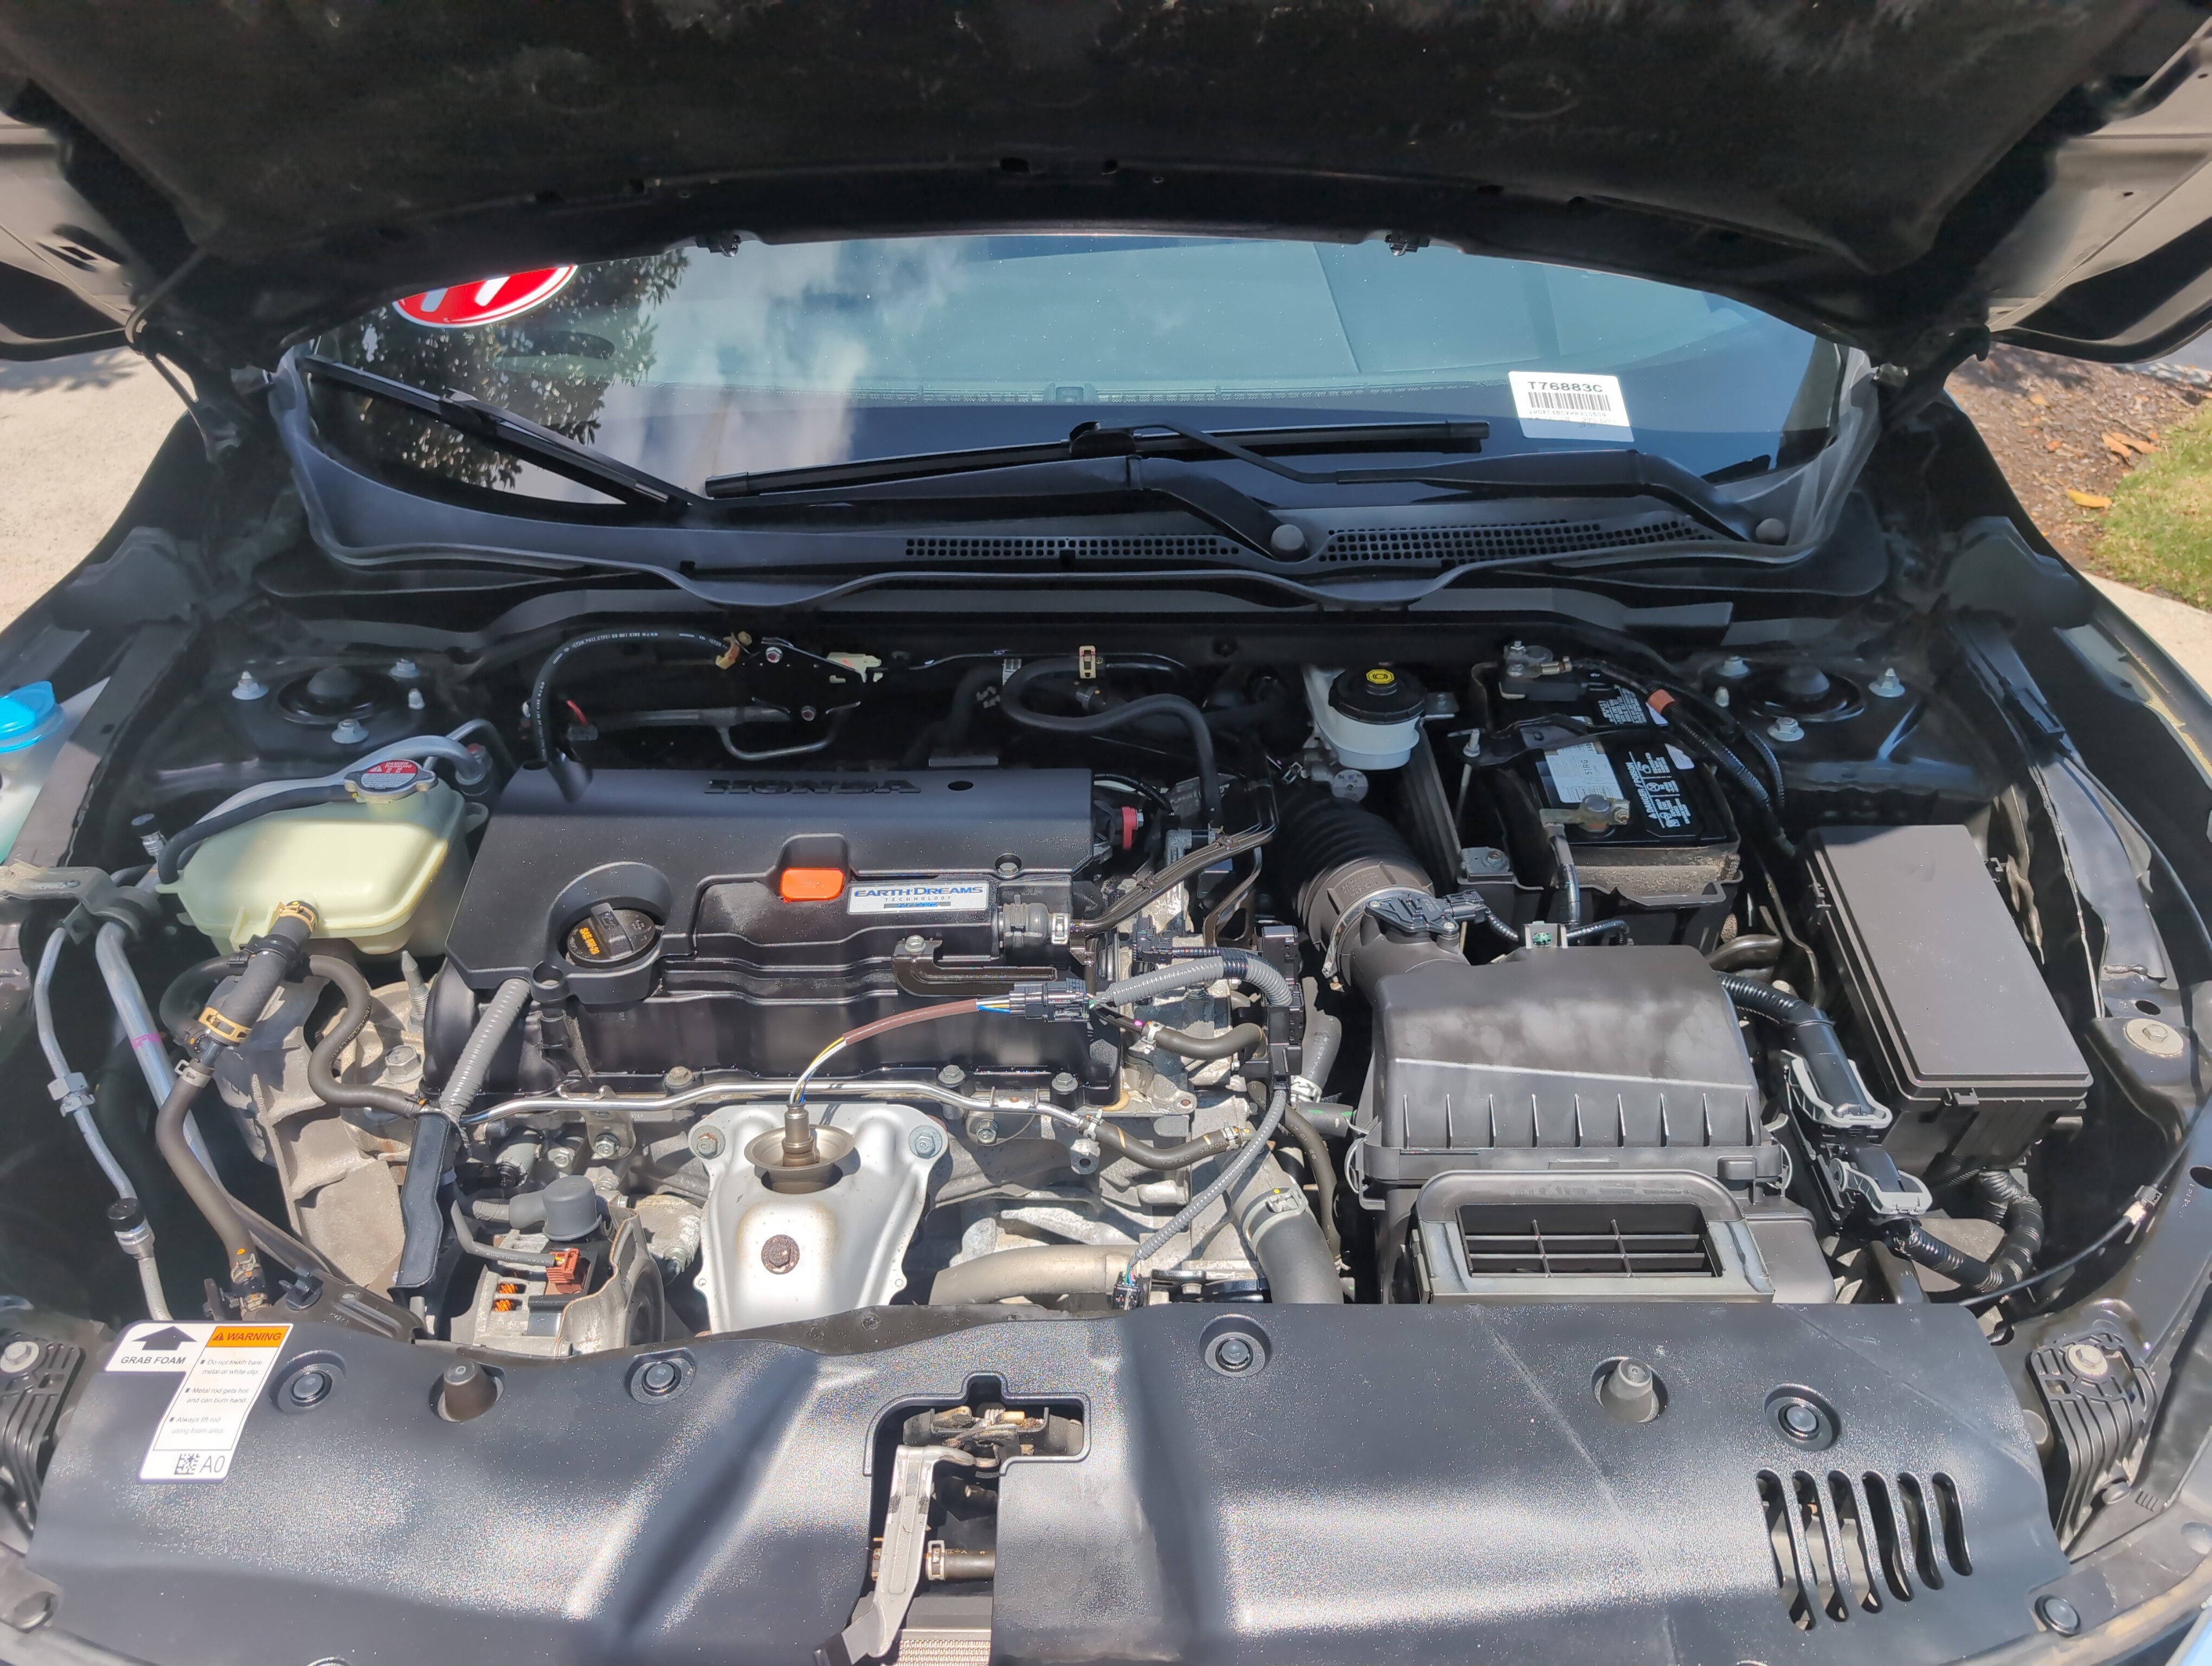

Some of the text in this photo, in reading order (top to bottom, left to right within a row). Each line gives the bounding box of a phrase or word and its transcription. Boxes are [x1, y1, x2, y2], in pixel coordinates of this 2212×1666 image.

[1527, 381, 1603, 393] T76883C
[1580, 759, 1593, 775] 51RG
[704, 779, 921, 793] HONDA
[227, 1332, 282, 1341] WARNING
[120, 1356, 187, 1364] GRAB FOAM
